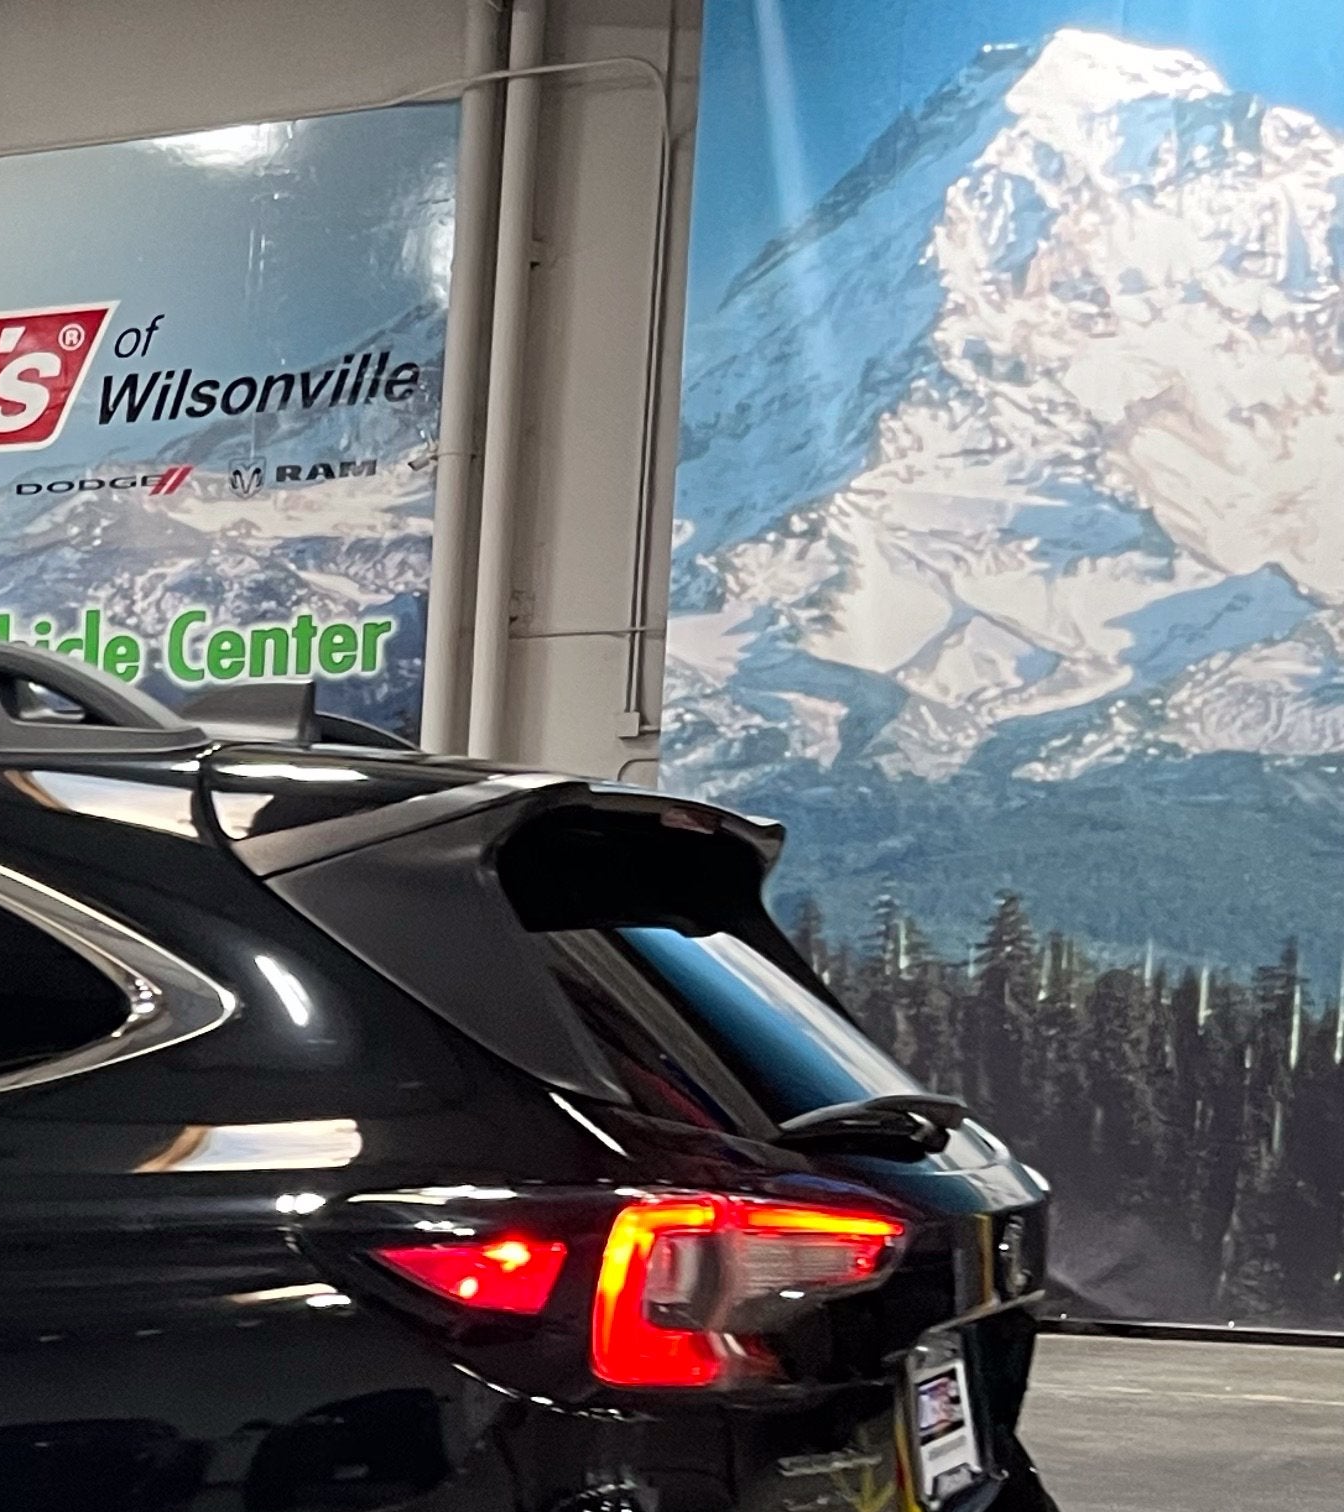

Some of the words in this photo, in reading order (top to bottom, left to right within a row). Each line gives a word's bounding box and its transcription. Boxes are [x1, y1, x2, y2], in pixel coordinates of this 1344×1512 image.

[114, 313, 165, 359] of
[98, 350, 420, 426] Wilsonville
[15, 473, 168, 496] DODGE
[275, 459, 378, 483] RAM
[168, 609, 392, 682] Center
